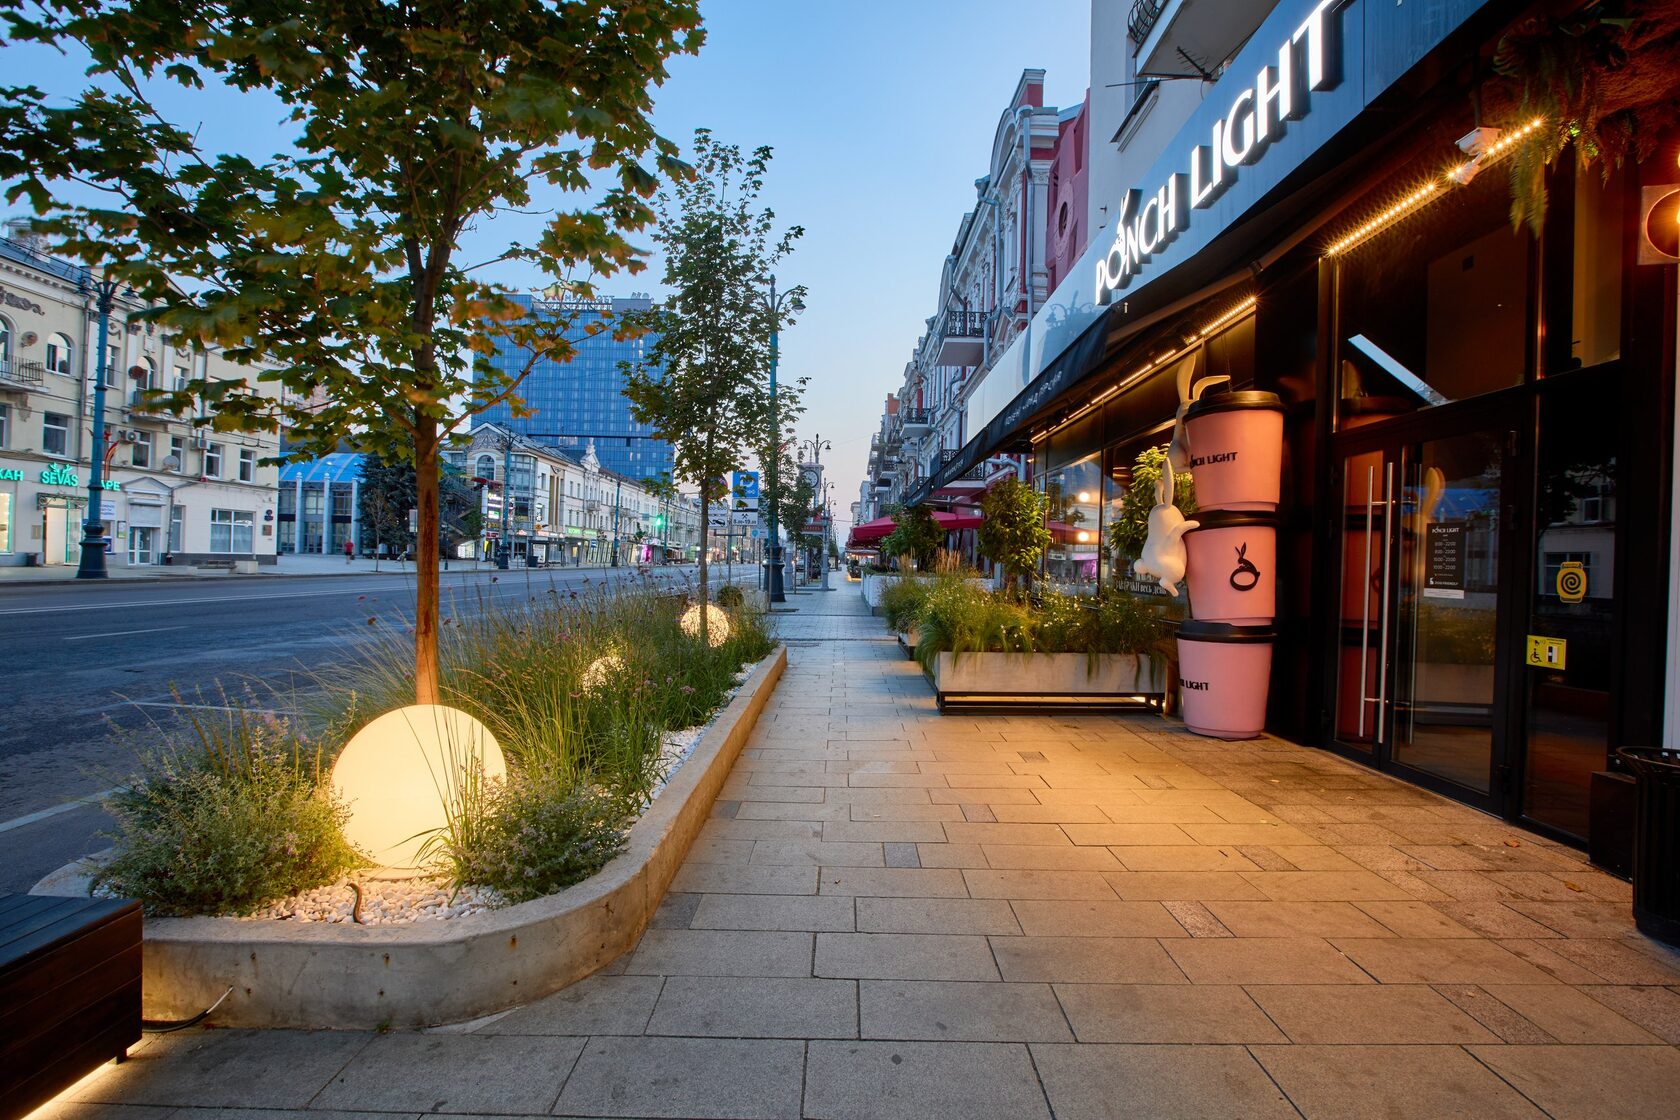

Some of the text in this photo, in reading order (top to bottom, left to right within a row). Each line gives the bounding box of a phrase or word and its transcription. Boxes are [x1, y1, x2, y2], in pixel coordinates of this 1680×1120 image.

[1190, 0, 1340, 209] LIGHT
[1207, 451, 1238, 464] LIGHT
[41, 470, 78, 487] SEVAS
[1186, 680, 1209, 690] LIGHT
